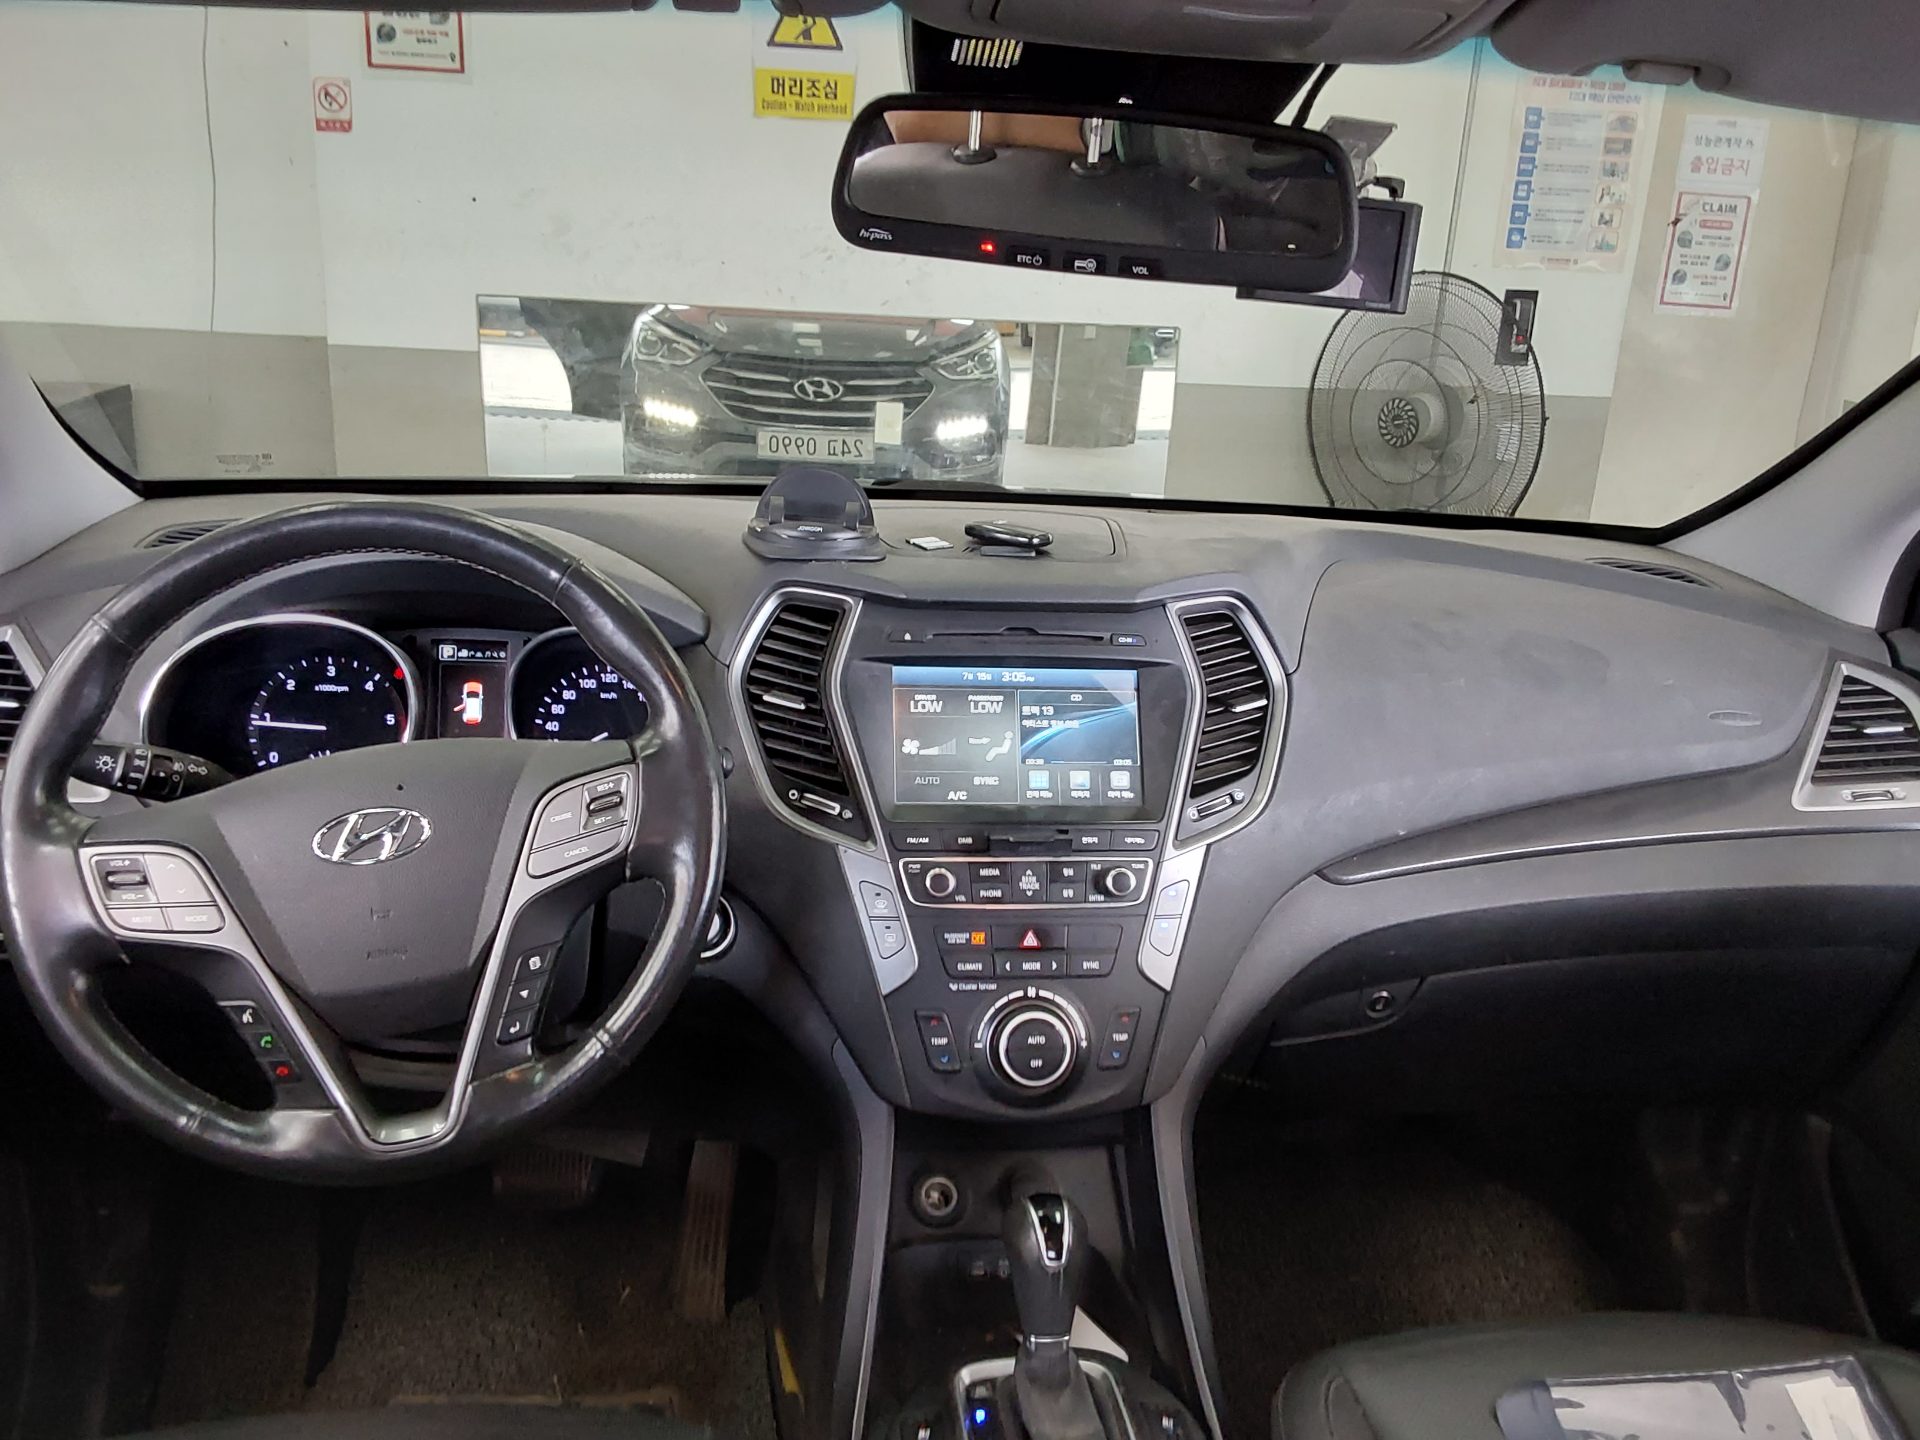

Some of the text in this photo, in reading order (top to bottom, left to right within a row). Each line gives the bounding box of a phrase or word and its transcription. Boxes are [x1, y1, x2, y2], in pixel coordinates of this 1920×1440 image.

[770, 76, 838, 100] 머리조심
[1690, 155, 1751, 177] 출입금지
[1702, 201, 1738, 214] CLAIM
[1017, 254, 1032, 264] ETC
[1132, 265, 1149, 275] VOL
[326, 665, 336, 677] 3
[1001, 671, 1027, 682] 3:05
[578, 678, 597, 689] 100
[600, 673, 618, 683] 120
[286, 679, 296, 691] 2
[364, 680, 374, 692] 4
[622, 679, 637, 690] 14
[562, 689, 576, 701] 80
[600, 692, 618, 700] km/h
[551, 704, 565, 715] 60
[910, 700, 943, 713] LOW
[970, 701, 1003, 714] LOW
[386, 714, 396, 725] 5
[545, 721, 560, 732] 40
[269, 751, 279, 763] 0
[915, 776, 941, 784] AUTO
[973, 776, 1000, 785] SYNC
[947, 790, 968, 801] A/C
[906, 836, 929, 844] FM/AM
[957, 836, 973, 845] DMB
[564, 846, 590, 858] CANCEL
[979, 868, 1000, 876] MEDIA
[1019, 882, 1040, 890] TRACK
[979, 889, 1002, 897] PHONE
[957, 962, 983, 971] CLIMATE
[1022, 961, 1041, 971] MODE
[931, 1037, 948, 1046] TEMP
[1027, 1035, 1046, 1045] AUTO
[1112, 1033, 1129, 1042] TEMP
[1030, 1059, 1043, 1068] OFF
